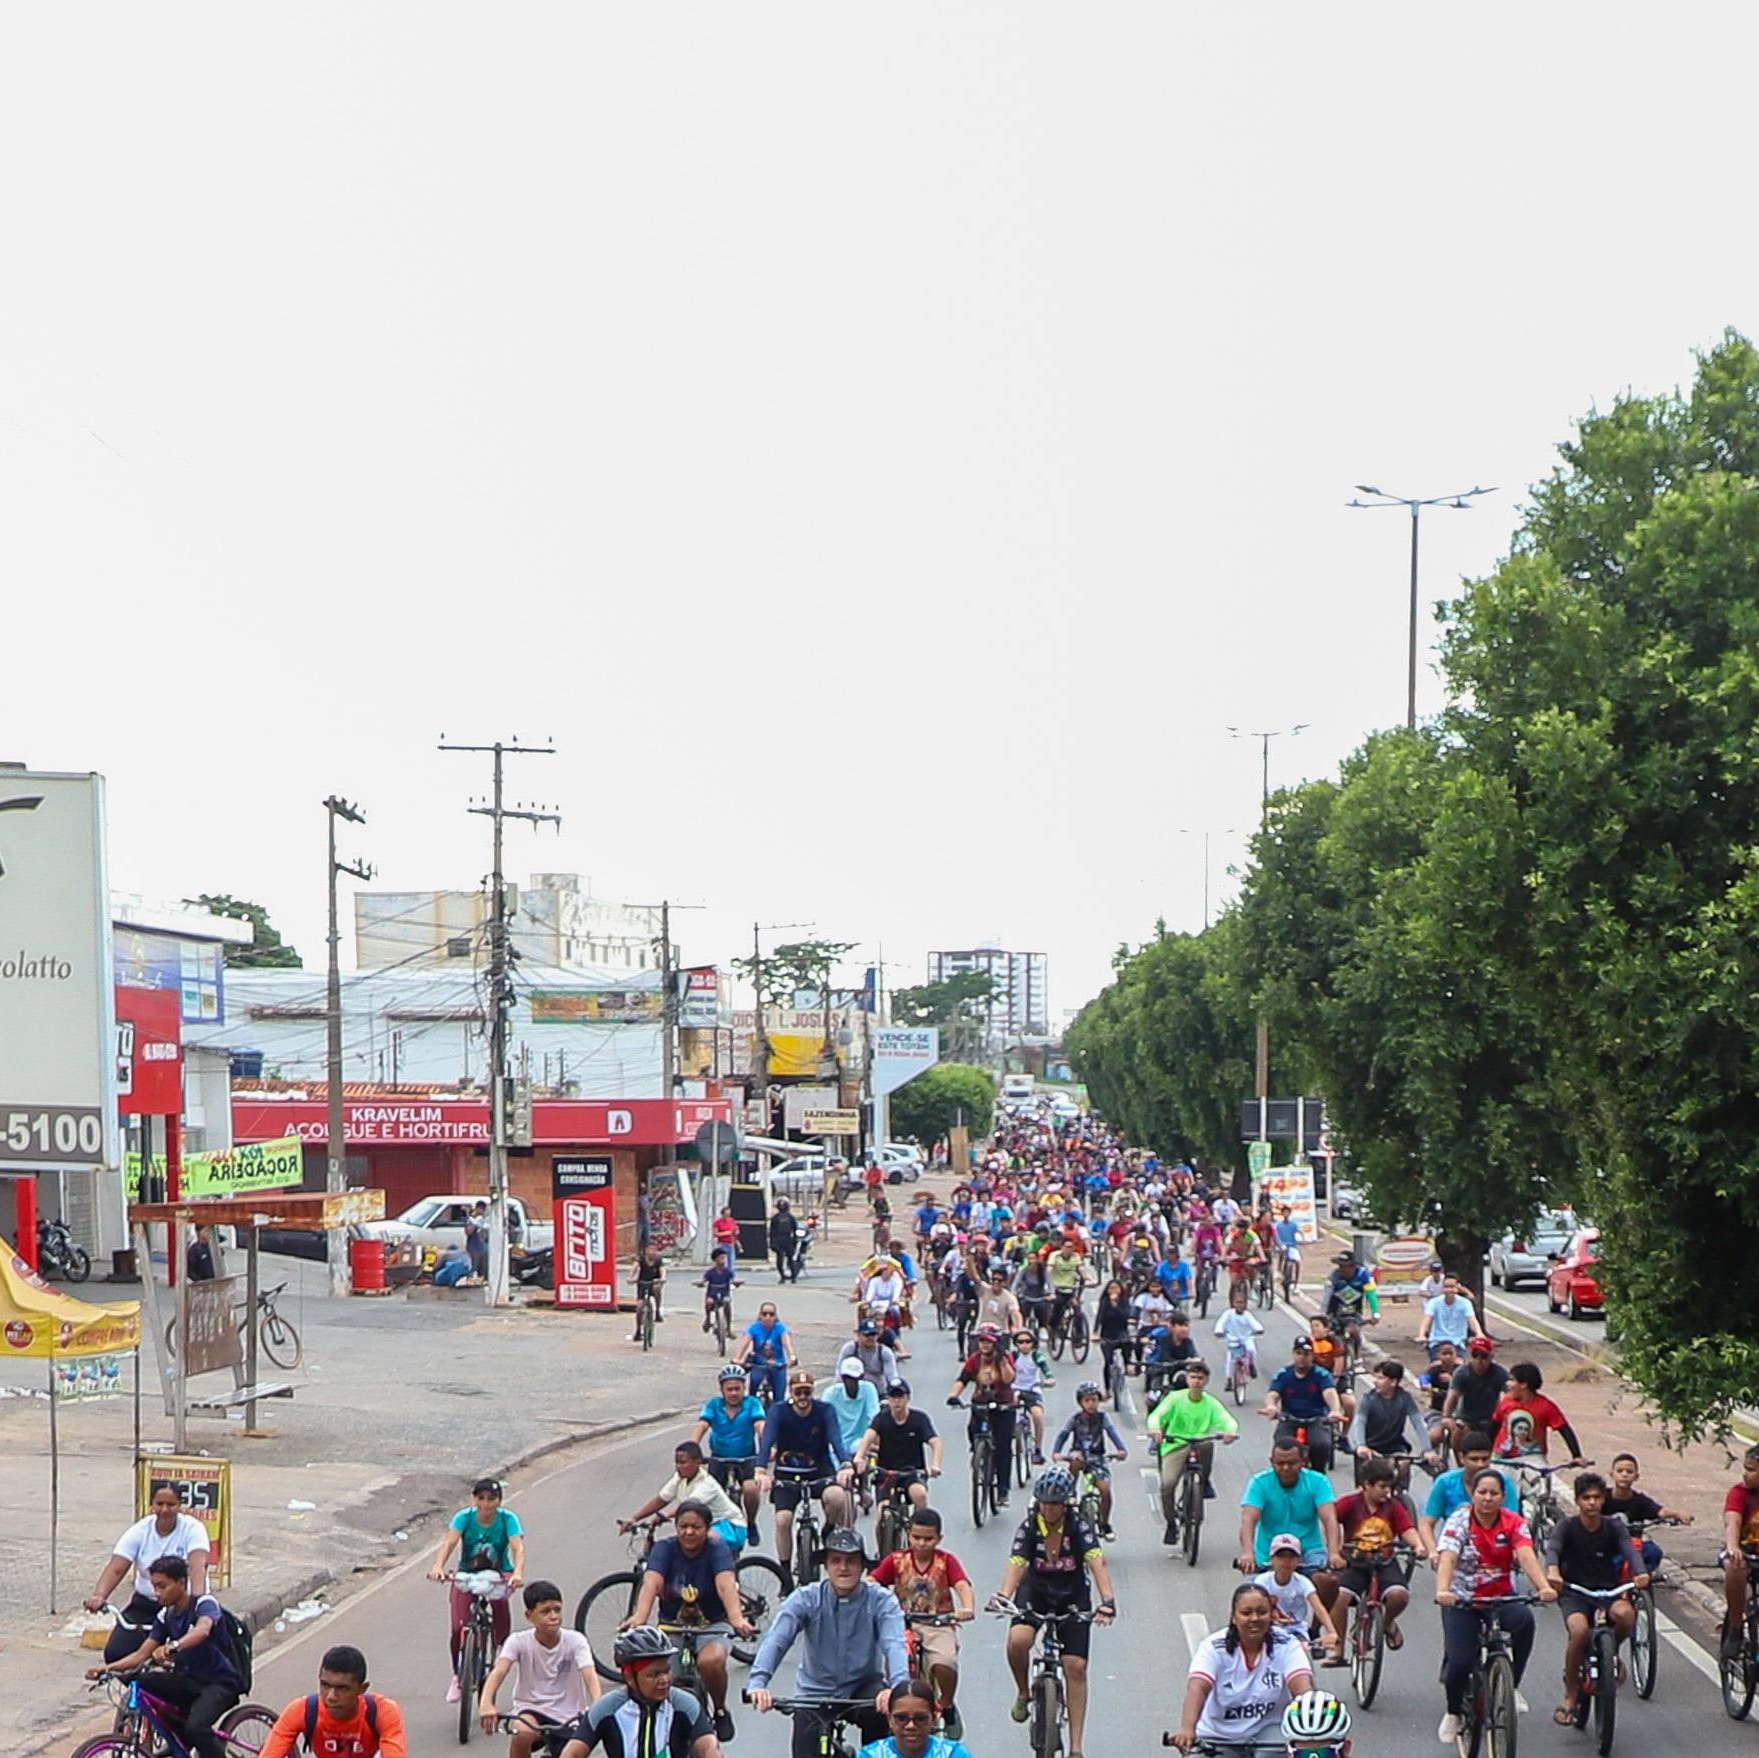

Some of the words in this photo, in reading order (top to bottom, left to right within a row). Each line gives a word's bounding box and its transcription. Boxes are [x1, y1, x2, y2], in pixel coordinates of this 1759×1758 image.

[351, 1107, 443, 1123] KRAVELIM
[283, 1122, 377, 1140] AÇOGUE
[382, 1122, 394, 1138] E
[399, 1122, 492, 1138] HORTIFRU
